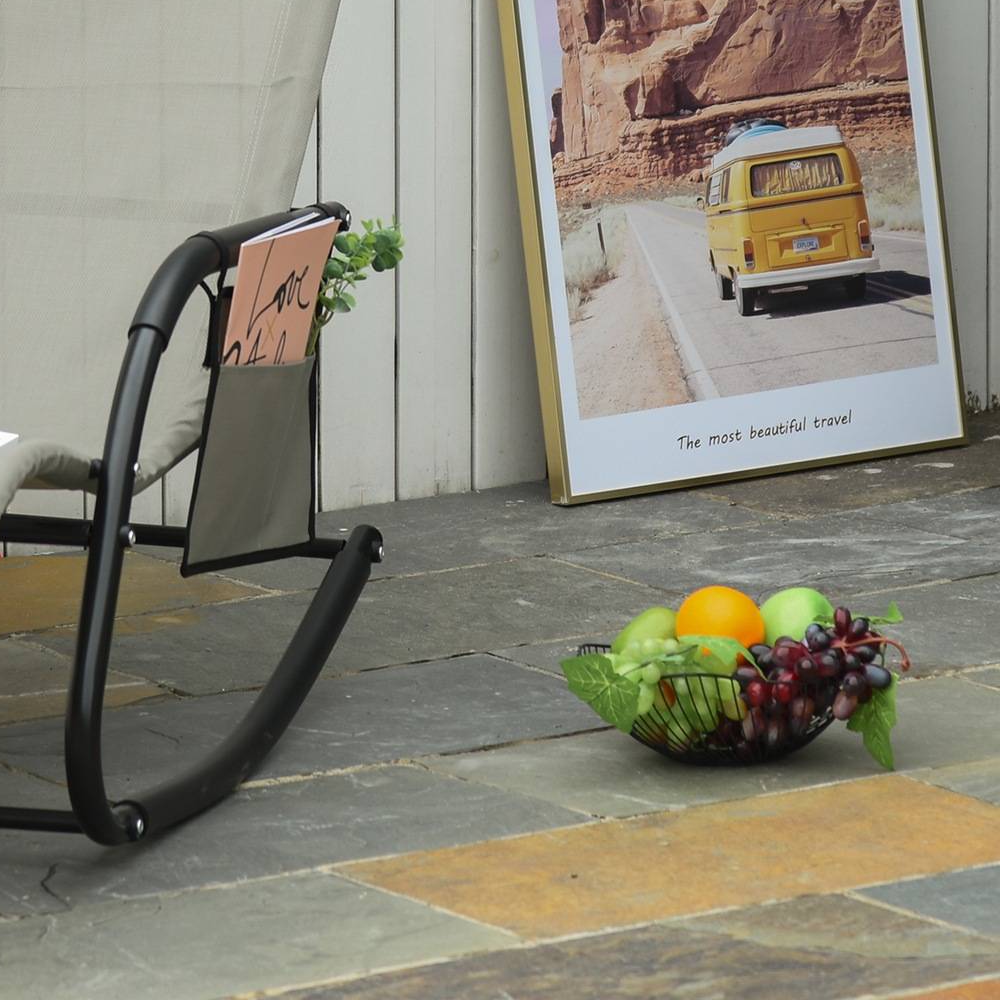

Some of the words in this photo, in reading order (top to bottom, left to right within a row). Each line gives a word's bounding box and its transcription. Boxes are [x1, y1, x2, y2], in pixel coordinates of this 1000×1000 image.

[677, 435, 702, 450] The
[708, 429, 743, 446] most
[749, 416, 807, 440] beautiful
[813, 409, 853, 429] travel
